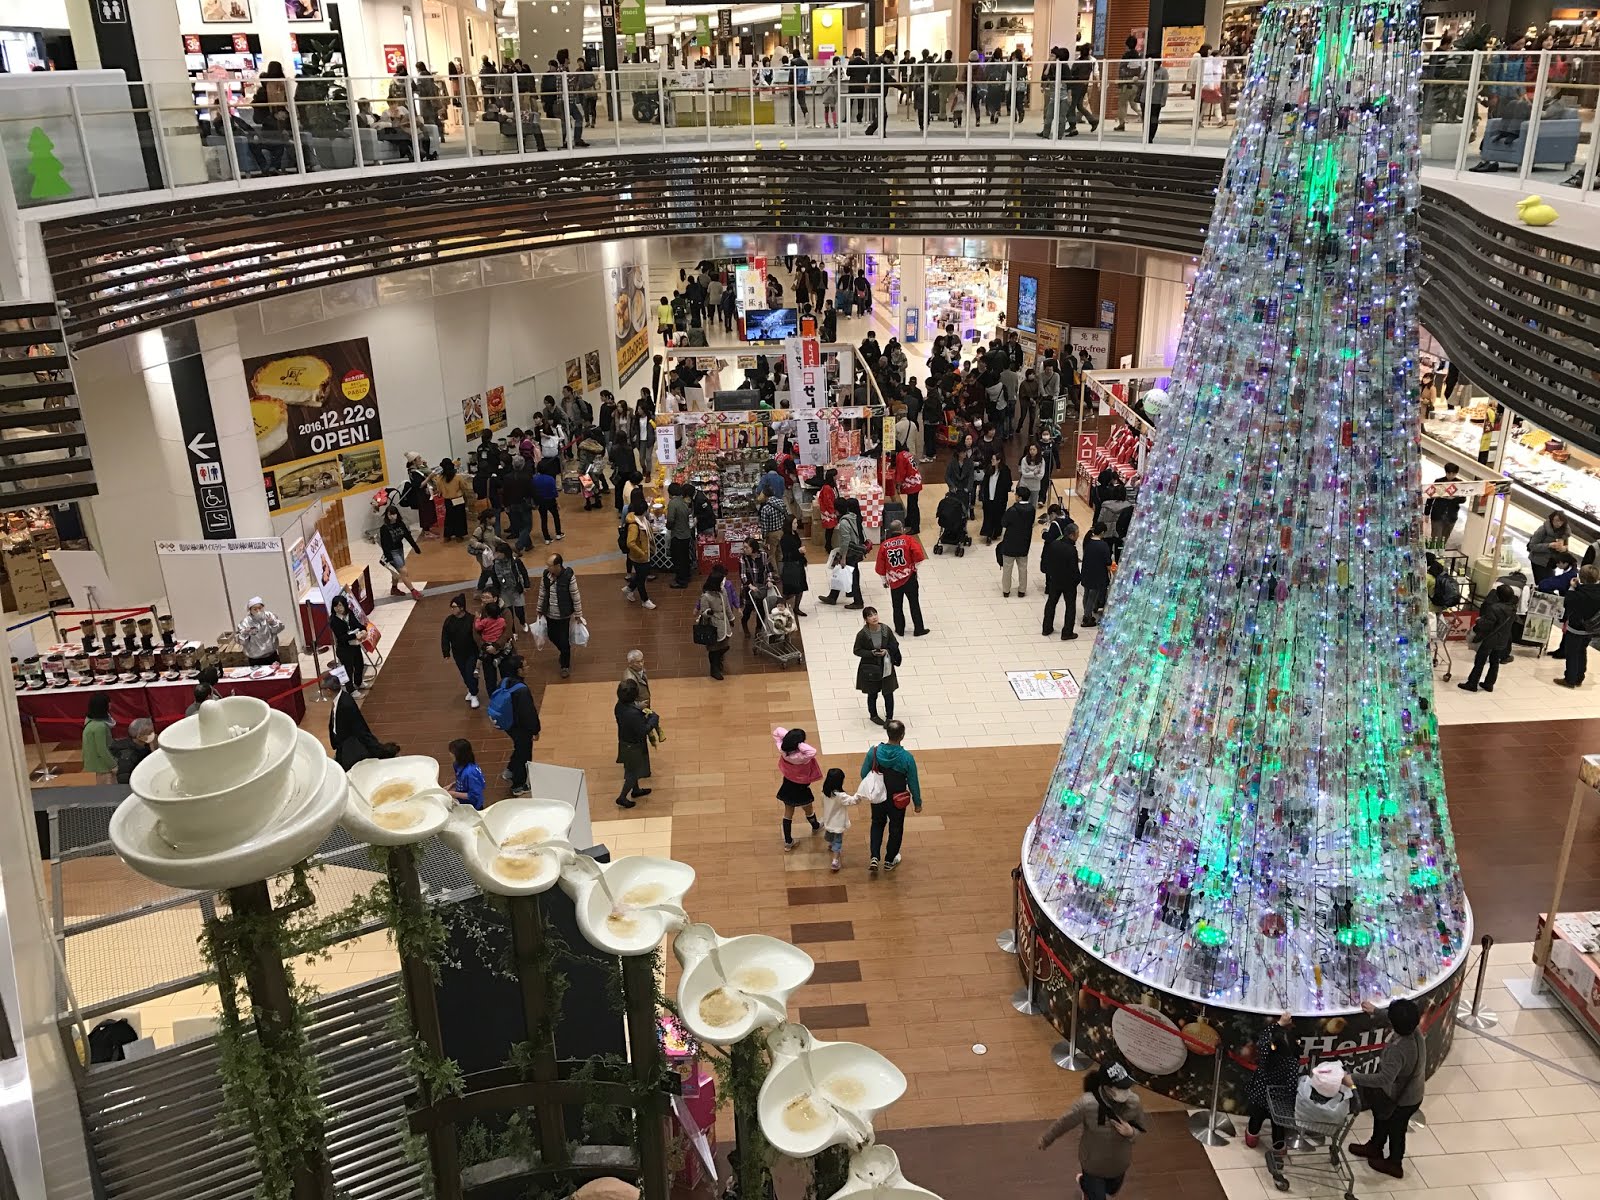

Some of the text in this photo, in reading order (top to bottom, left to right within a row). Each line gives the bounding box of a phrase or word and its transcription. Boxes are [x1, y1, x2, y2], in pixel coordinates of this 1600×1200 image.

[1073, 343, 1106, 354] Tax-free
[347, 388, 367, 396] PABLO
[310, 424, 370, 453] OPEN!
[1081, 436, 1094, 458] 入口
[887, 547, 907, 568] 祝
